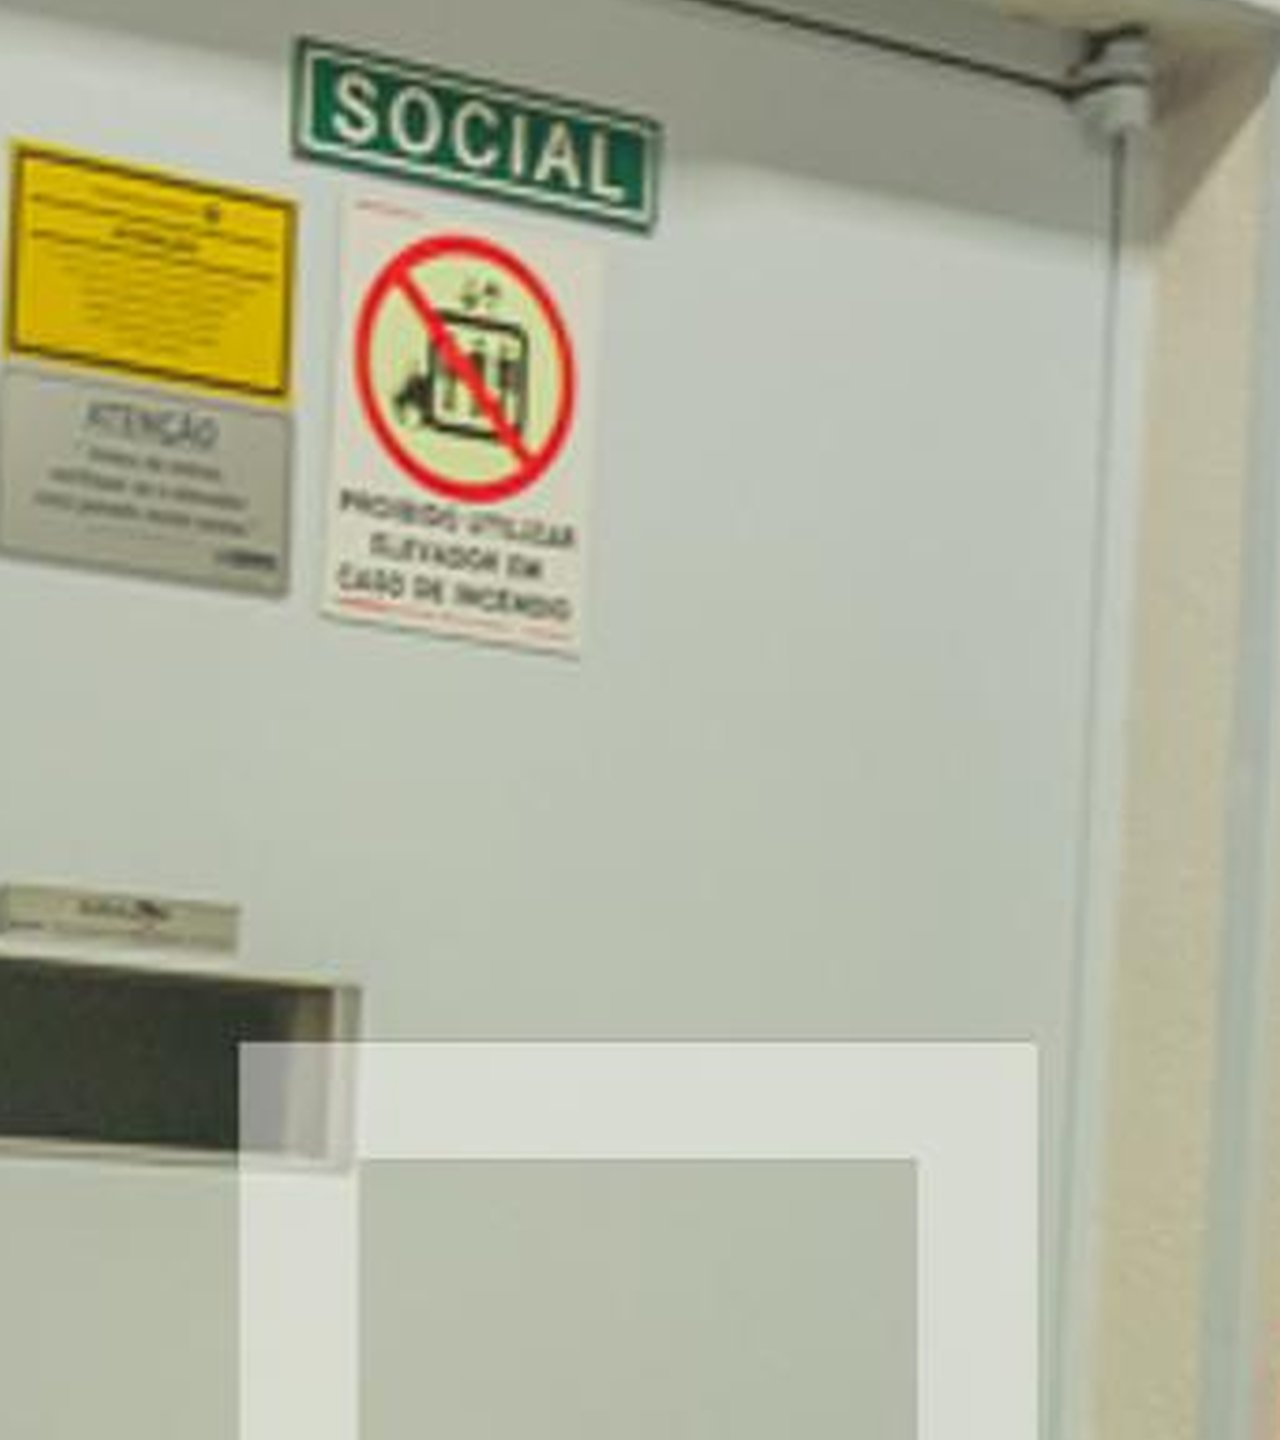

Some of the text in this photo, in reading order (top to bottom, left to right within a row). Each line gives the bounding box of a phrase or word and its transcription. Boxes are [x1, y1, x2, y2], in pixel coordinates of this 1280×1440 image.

[332, 71, 626, 202] SOCIAL
[81, 401, 219, 452] ATENÇÃO
[339, 487, 577, 548] PROIBIDO UTILIZAR
[369, 531, 543, 580] ELEVADOR EM
[337, 560, 405, 599] CASO
[413, 573, 444, 606] DE
